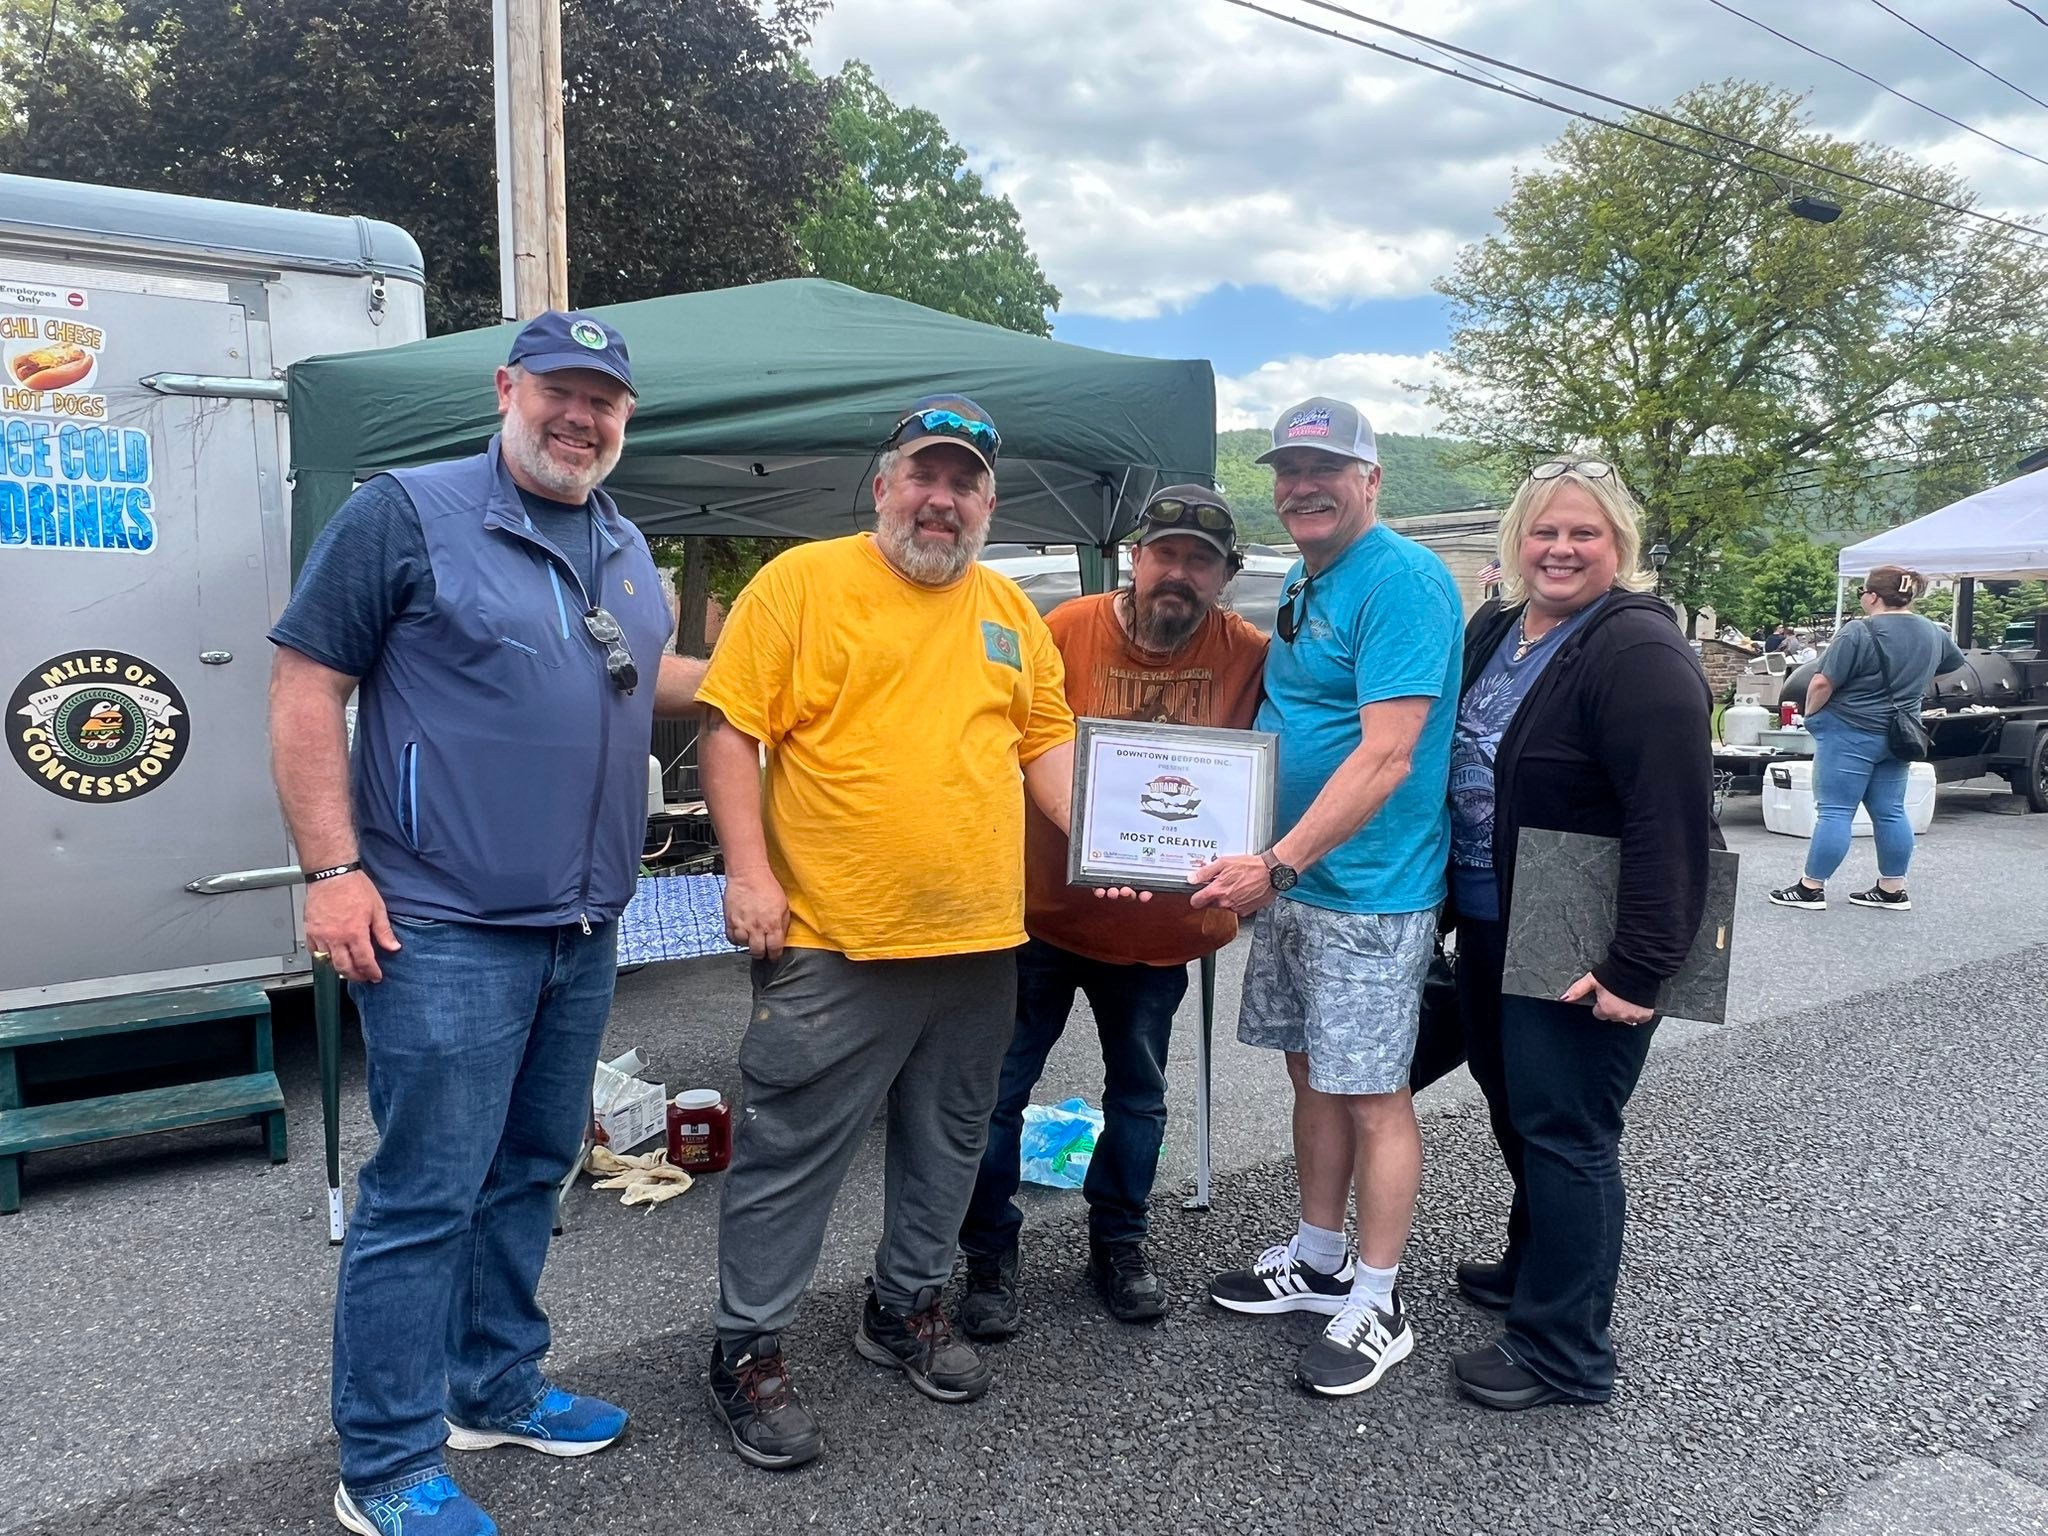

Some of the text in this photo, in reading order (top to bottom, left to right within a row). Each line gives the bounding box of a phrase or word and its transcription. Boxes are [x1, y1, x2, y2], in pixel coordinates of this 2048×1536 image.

[0, 285, 57, 297] Employees
[17, 295, 41, 304] Only
[0, 317, 102, 350] CHILI CHEESE
[3, 387, 104, 417] HOT DOGS
[59, 425, 149, 484] COLD
[0, 481, 153, 551] DRINKS
[41, 656, 157, 688] MILES OF
[38, 693, 59, 705] ESTD
[22, 727, 176, 796] CONCESSIONS
[1116, 749, 1232, 767] DOWNTOWN BEDFORD INC.
[1120, 832, 1218, 849] MOST CREATIVE
